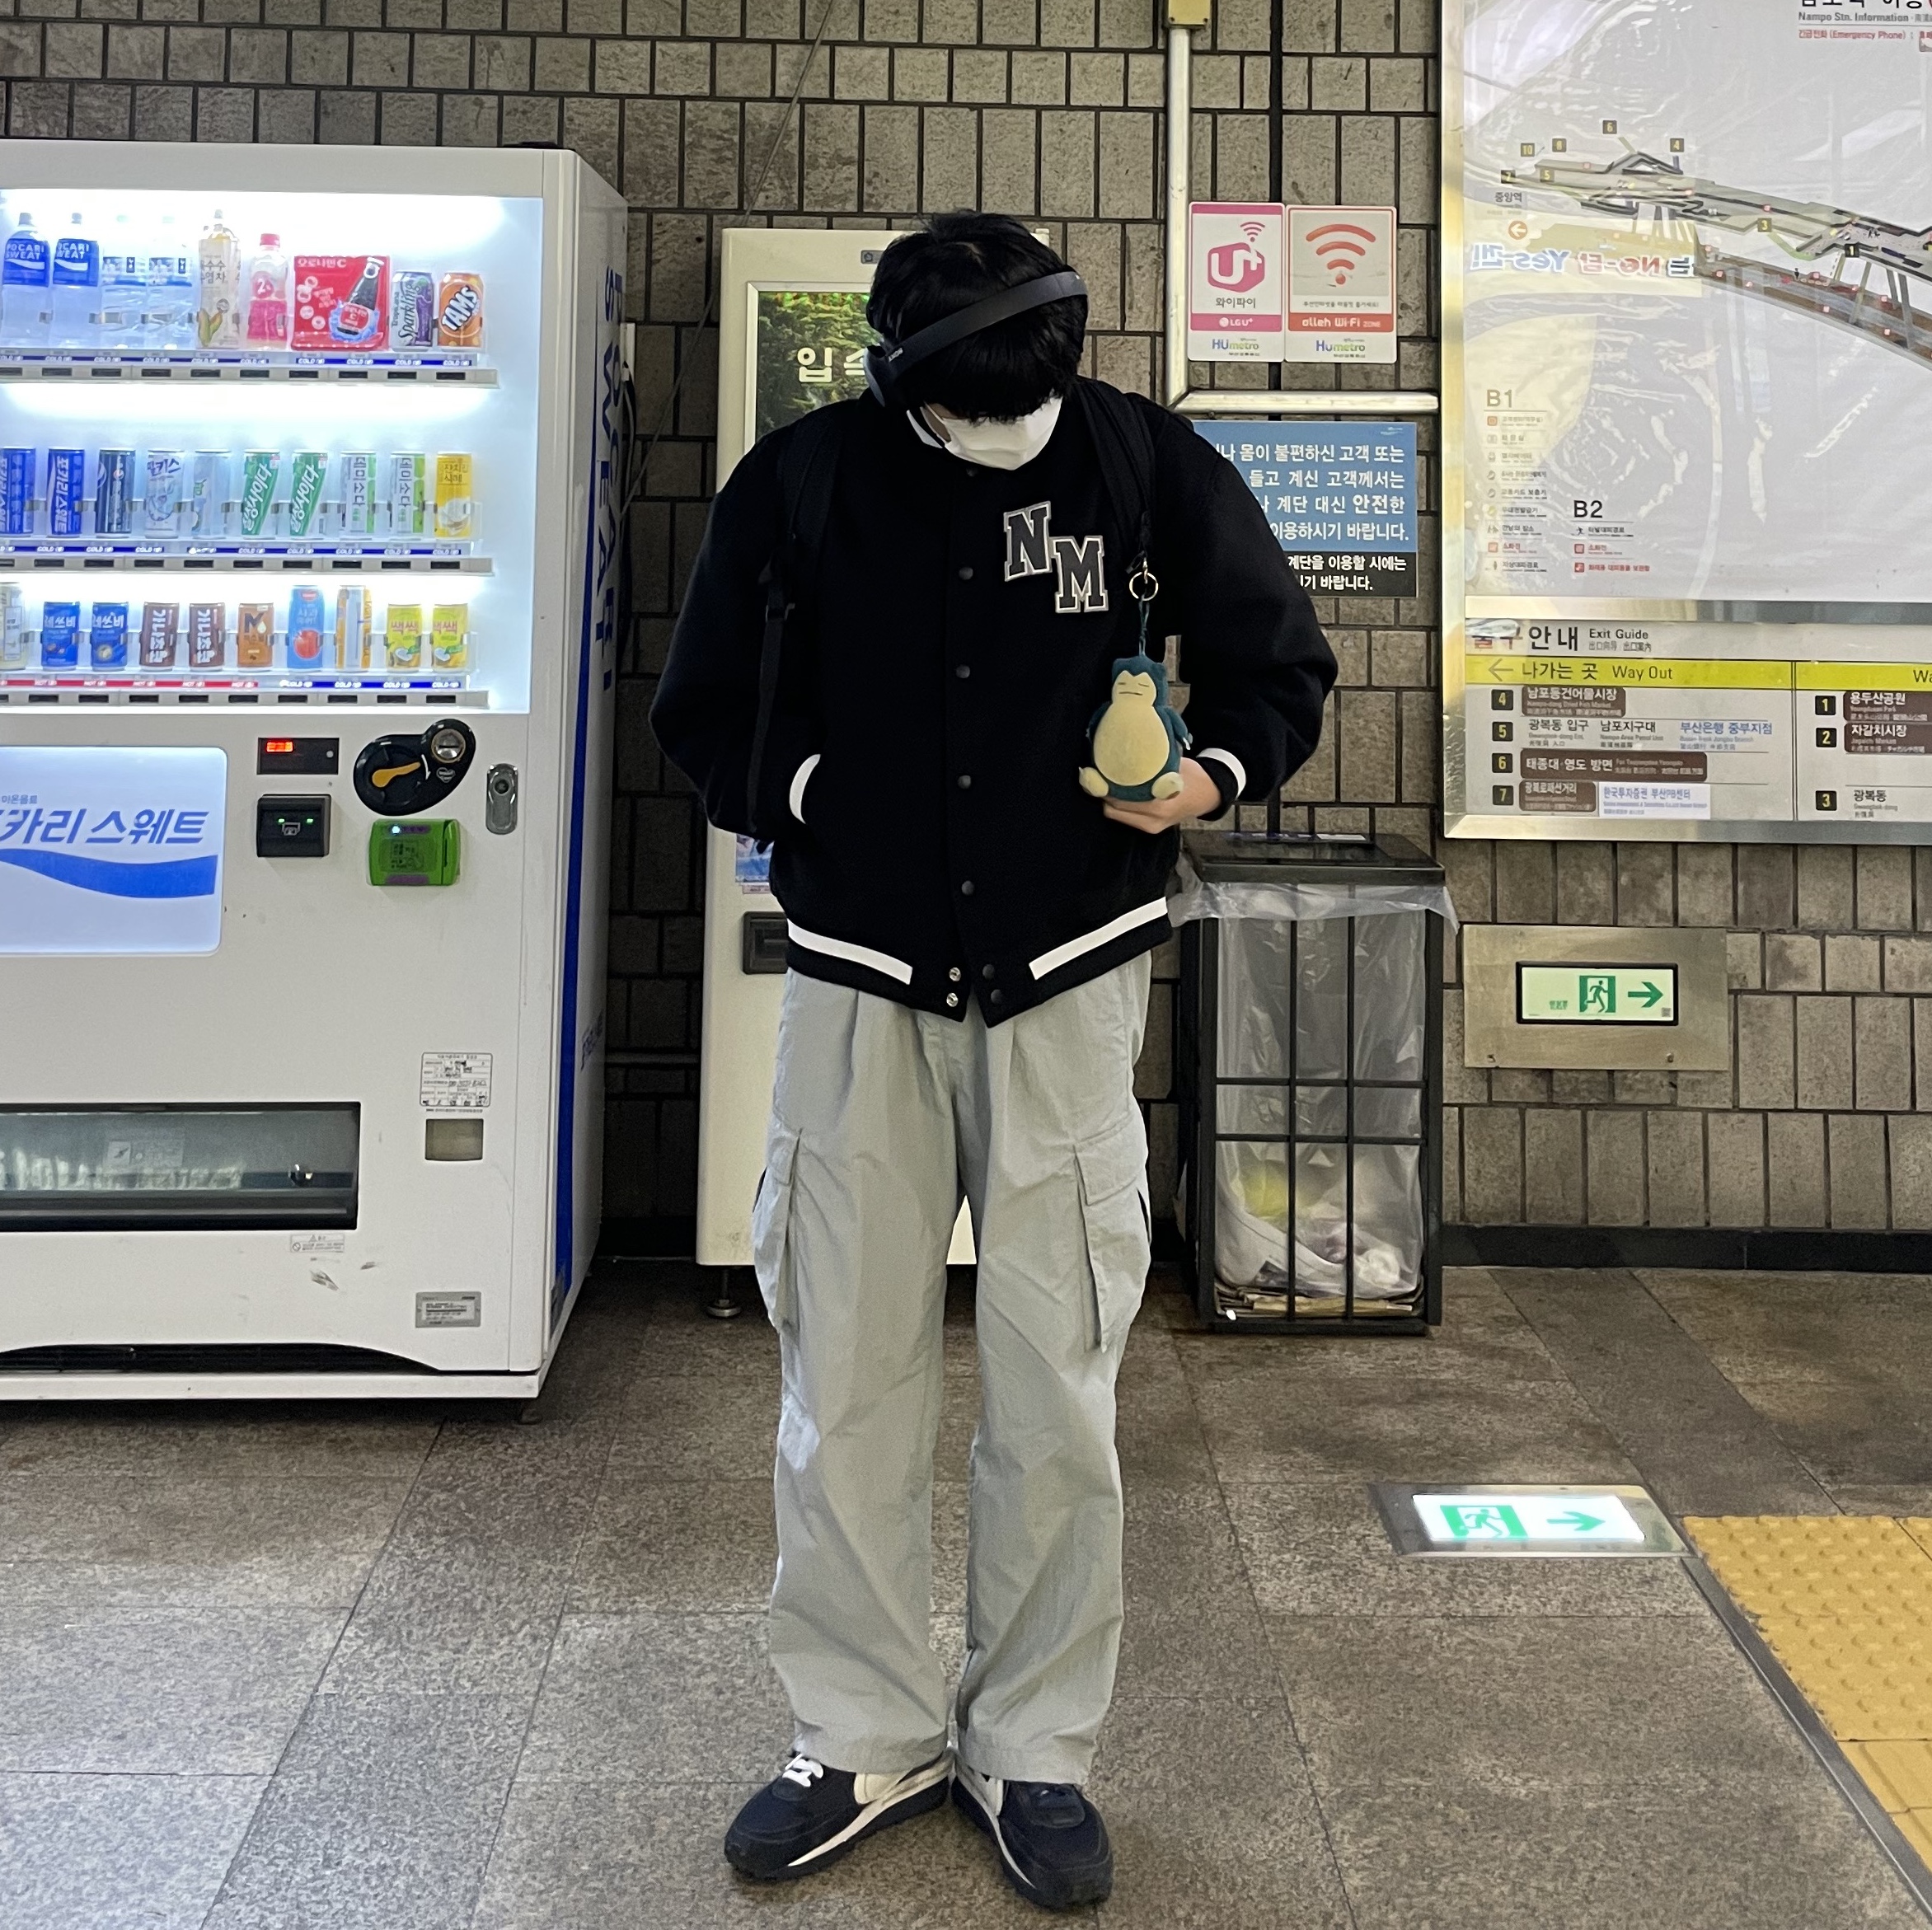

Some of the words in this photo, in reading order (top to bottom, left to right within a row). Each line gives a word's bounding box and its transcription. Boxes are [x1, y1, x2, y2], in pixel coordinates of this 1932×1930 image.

[1798, 12, 1831, 22] Nampo
[1835, 12, 1852, 21] Stn.
[1855, 12, 1909, 22] Information
[1878, 30, 1906, 40] Phone)
[1494, 192, 1522, 203] 중앙역
[398, 279, 420, 339] Sparkling
[442, 285, 478, 331] TAMS
[1216, 297, 1256, 308] 와이파이
[1487, 390, 1513, 408] B1
[1240, 444, 1269, 461] 몸이
[1274, 445, 1334, 462] 불편하신
[1339, 445, 1369, 462] 고객
[1374, 445, 1405, 462] 또는
[354, 457, 367, 506] 데미소다
[399, 457, 412, 508] 데미소다
[1250, 470, 1280, 487] 들고
[1288, 470, 1319, 488] 계신
[1327, 471, 1405, 489] 고객께서는
[1277, 496, 1307, 513] 계단
[1315, 496, 1346, 513] 대신
[1353, 494, 1405, 514] 안전한
[1573, 499, 1603, 518] B2
[1270, 522, 1342, 541] 이용하시기
[1347, 522, 1409, 541] 바랍니다.
[1287, 555, 1325, 570] 계단을
[1329, 555, 1366, 570] 이용할
[1369, 555, 1407, 571] 시에는
[1320, 575, 1373, 591] 바랍니다.
[1589, 629, 1611, 639] Exit
[1616, 629, 1648, 639] Guide
[1522, 662, 1573, 680] 나가는
[1582, 663, 1598, 680] 곳
[1612, 666, 1644, 682] Way
[1648, 666, 1673, 680] Out
[1850, 691, 1906, 705] 용두산공원
[1529, 719, 1562, 731] 광복동
[1567, 719, 1589, 732] 입구
[1600, 719, 1656, 733] 남포지구대
[1681, 722, 1723, 734] 부산은행
[1728, 723, 1772, 734] 중부지점
[1851, 724, 1907, 738] 자갈치시장
[1591, 758, 1613, 771] 방면
[1854, 789, 1887, 803] 광복동
[0, 808, 87, 844] 카리
[86, 808, 209, 844] 스웨트
